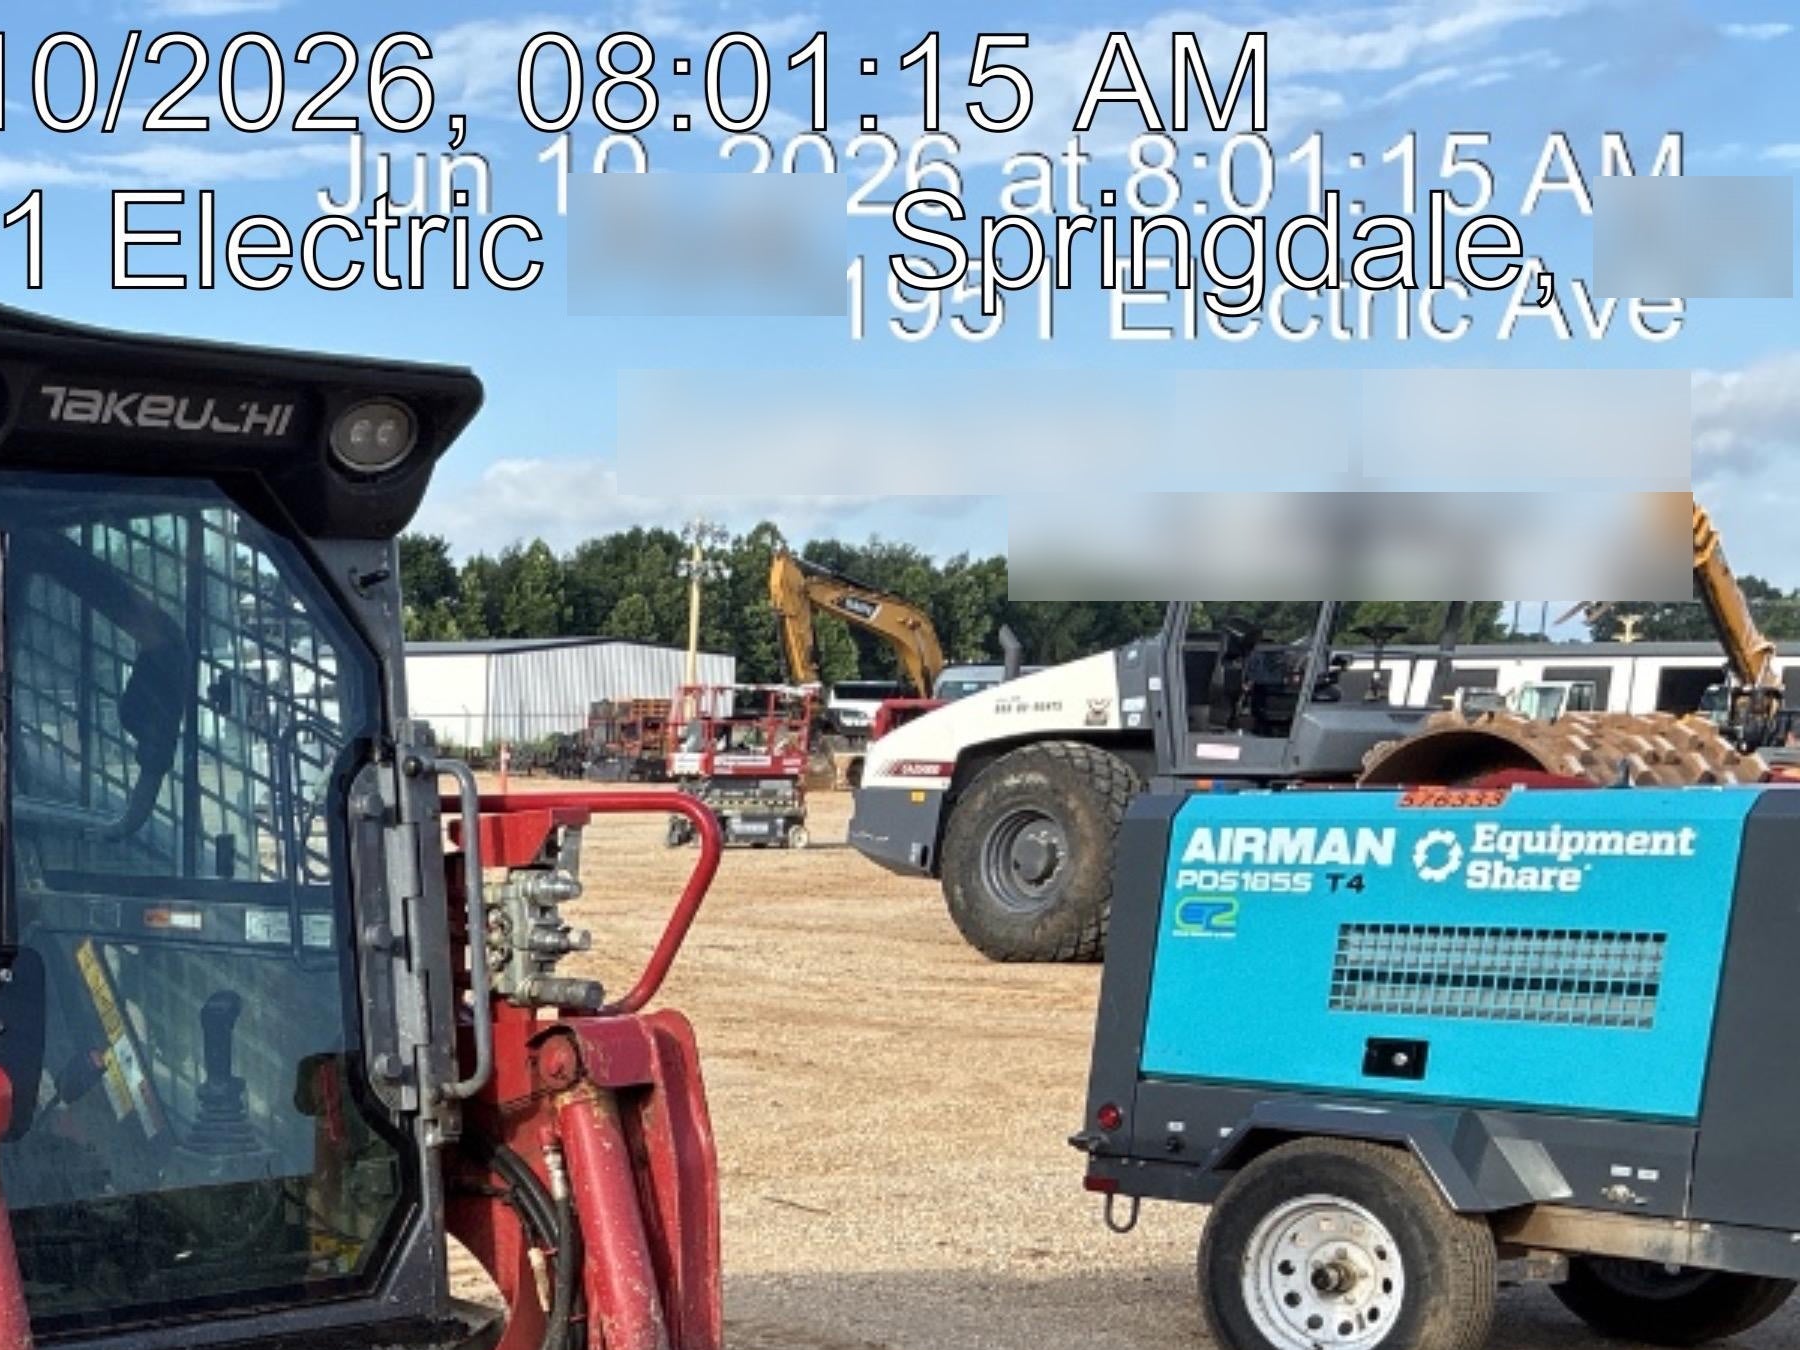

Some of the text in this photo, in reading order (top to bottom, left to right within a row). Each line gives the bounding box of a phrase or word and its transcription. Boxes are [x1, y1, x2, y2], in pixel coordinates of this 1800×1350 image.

[1181, 826, 1397, 867] AIRMAN
[1470, 822, 1698, 863] Equipment
[1326, 872, 1366, 894] T4
[1465, 859, 1583, 892] Share
